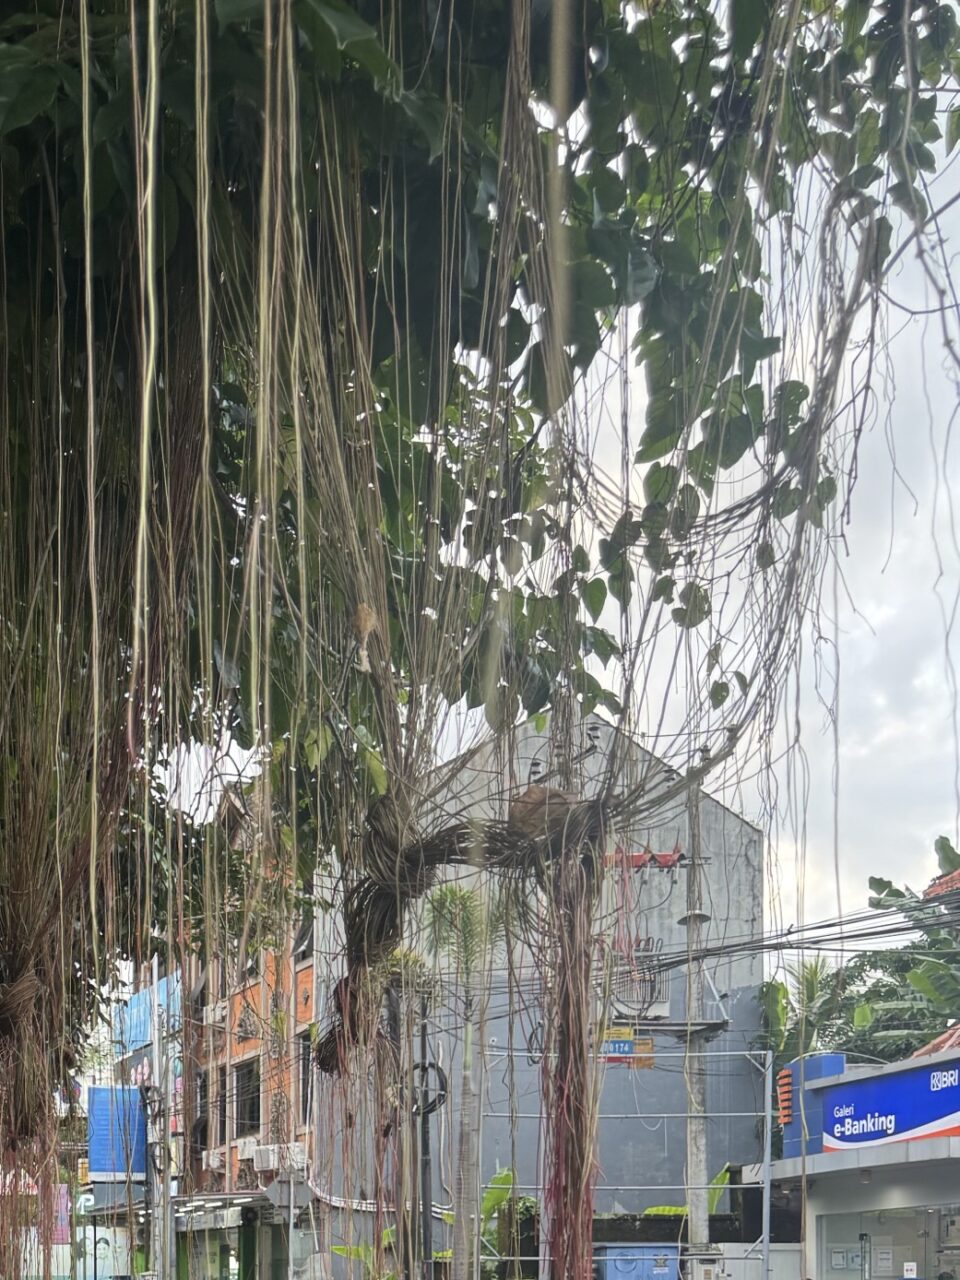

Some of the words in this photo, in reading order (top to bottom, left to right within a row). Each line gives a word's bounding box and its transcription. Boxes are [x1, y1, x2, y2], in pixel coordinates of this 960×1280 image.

[941, 1069, 959, 1088] BRI
[834, 1104, 855, 1118] Galeri
[834, 1112, 896, 1137] e-Banking
